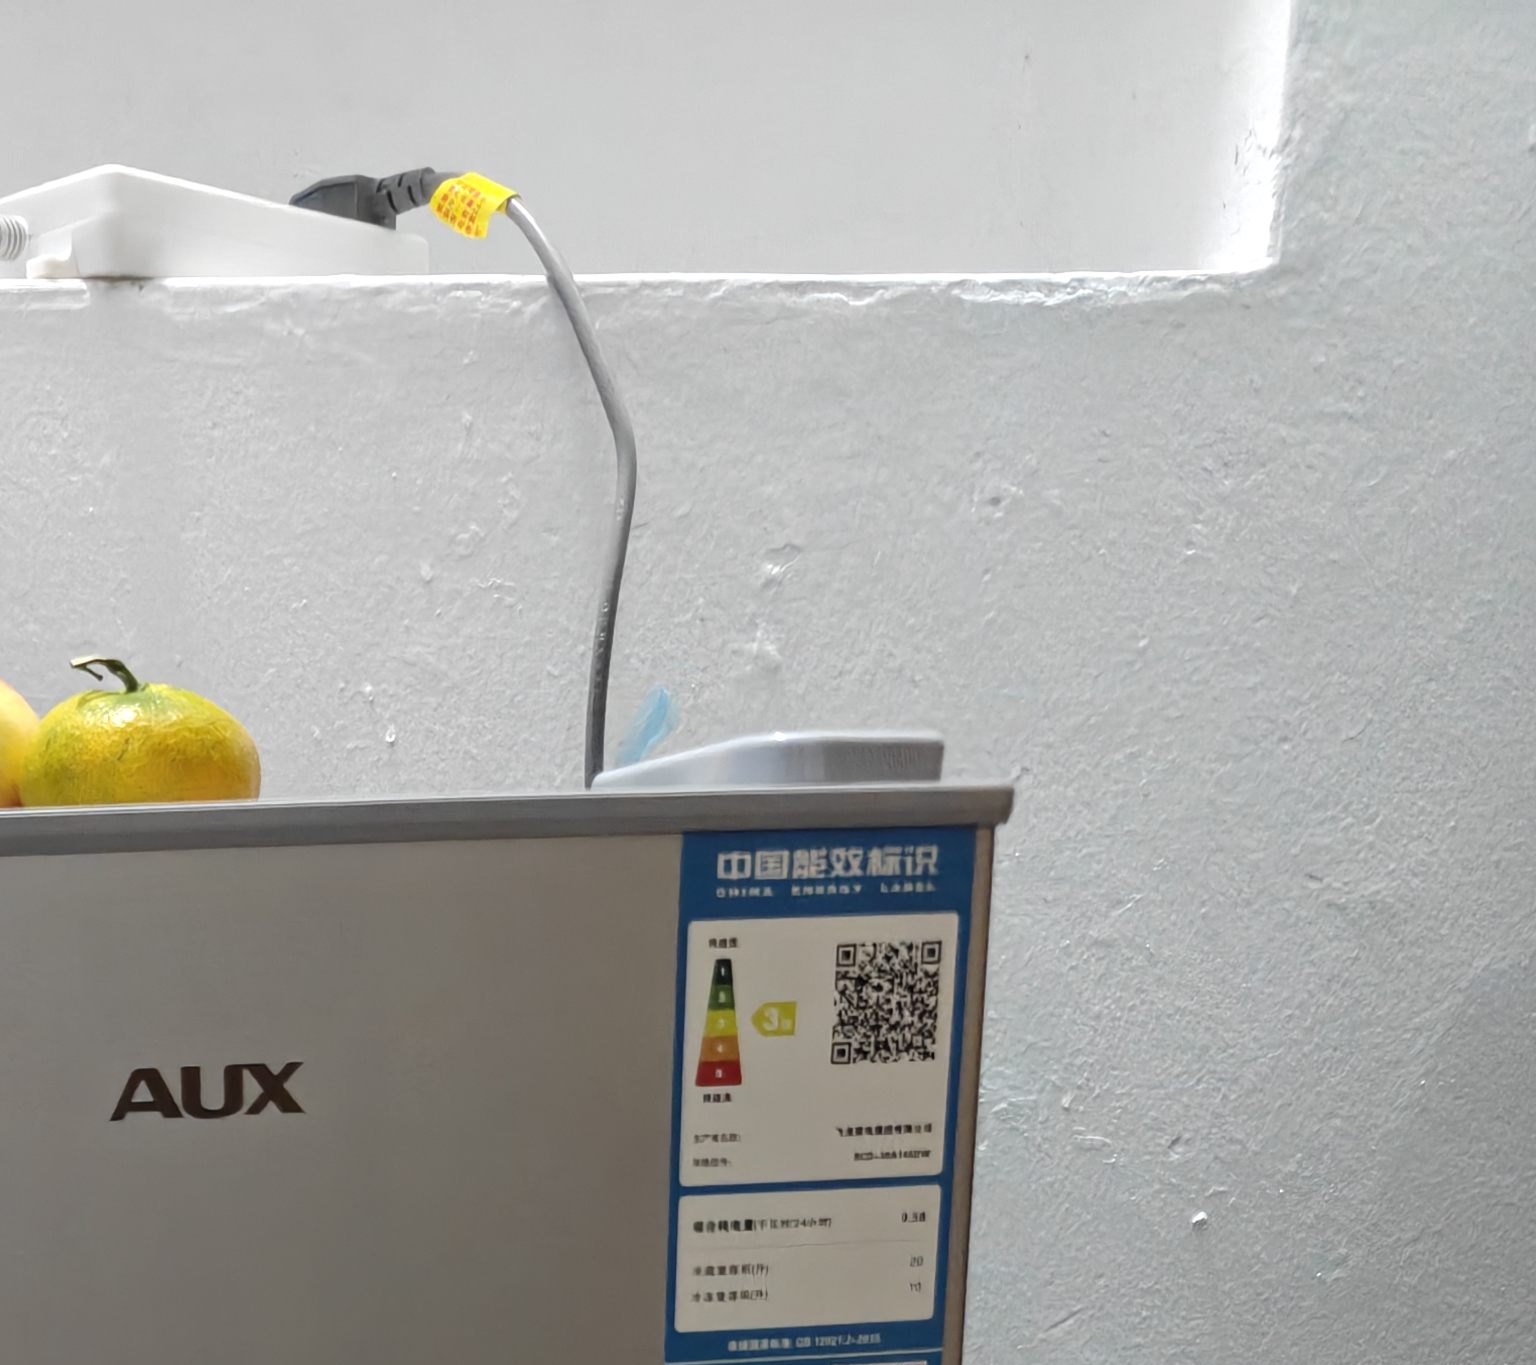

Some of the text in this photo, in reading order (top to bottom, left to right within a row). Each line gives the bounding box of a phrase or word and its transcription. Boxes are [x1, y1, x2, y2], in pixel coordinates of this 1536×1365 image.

[716, 845, 939, 880] 中国能效标识
[109, 1061, 307, 1121] AUX
